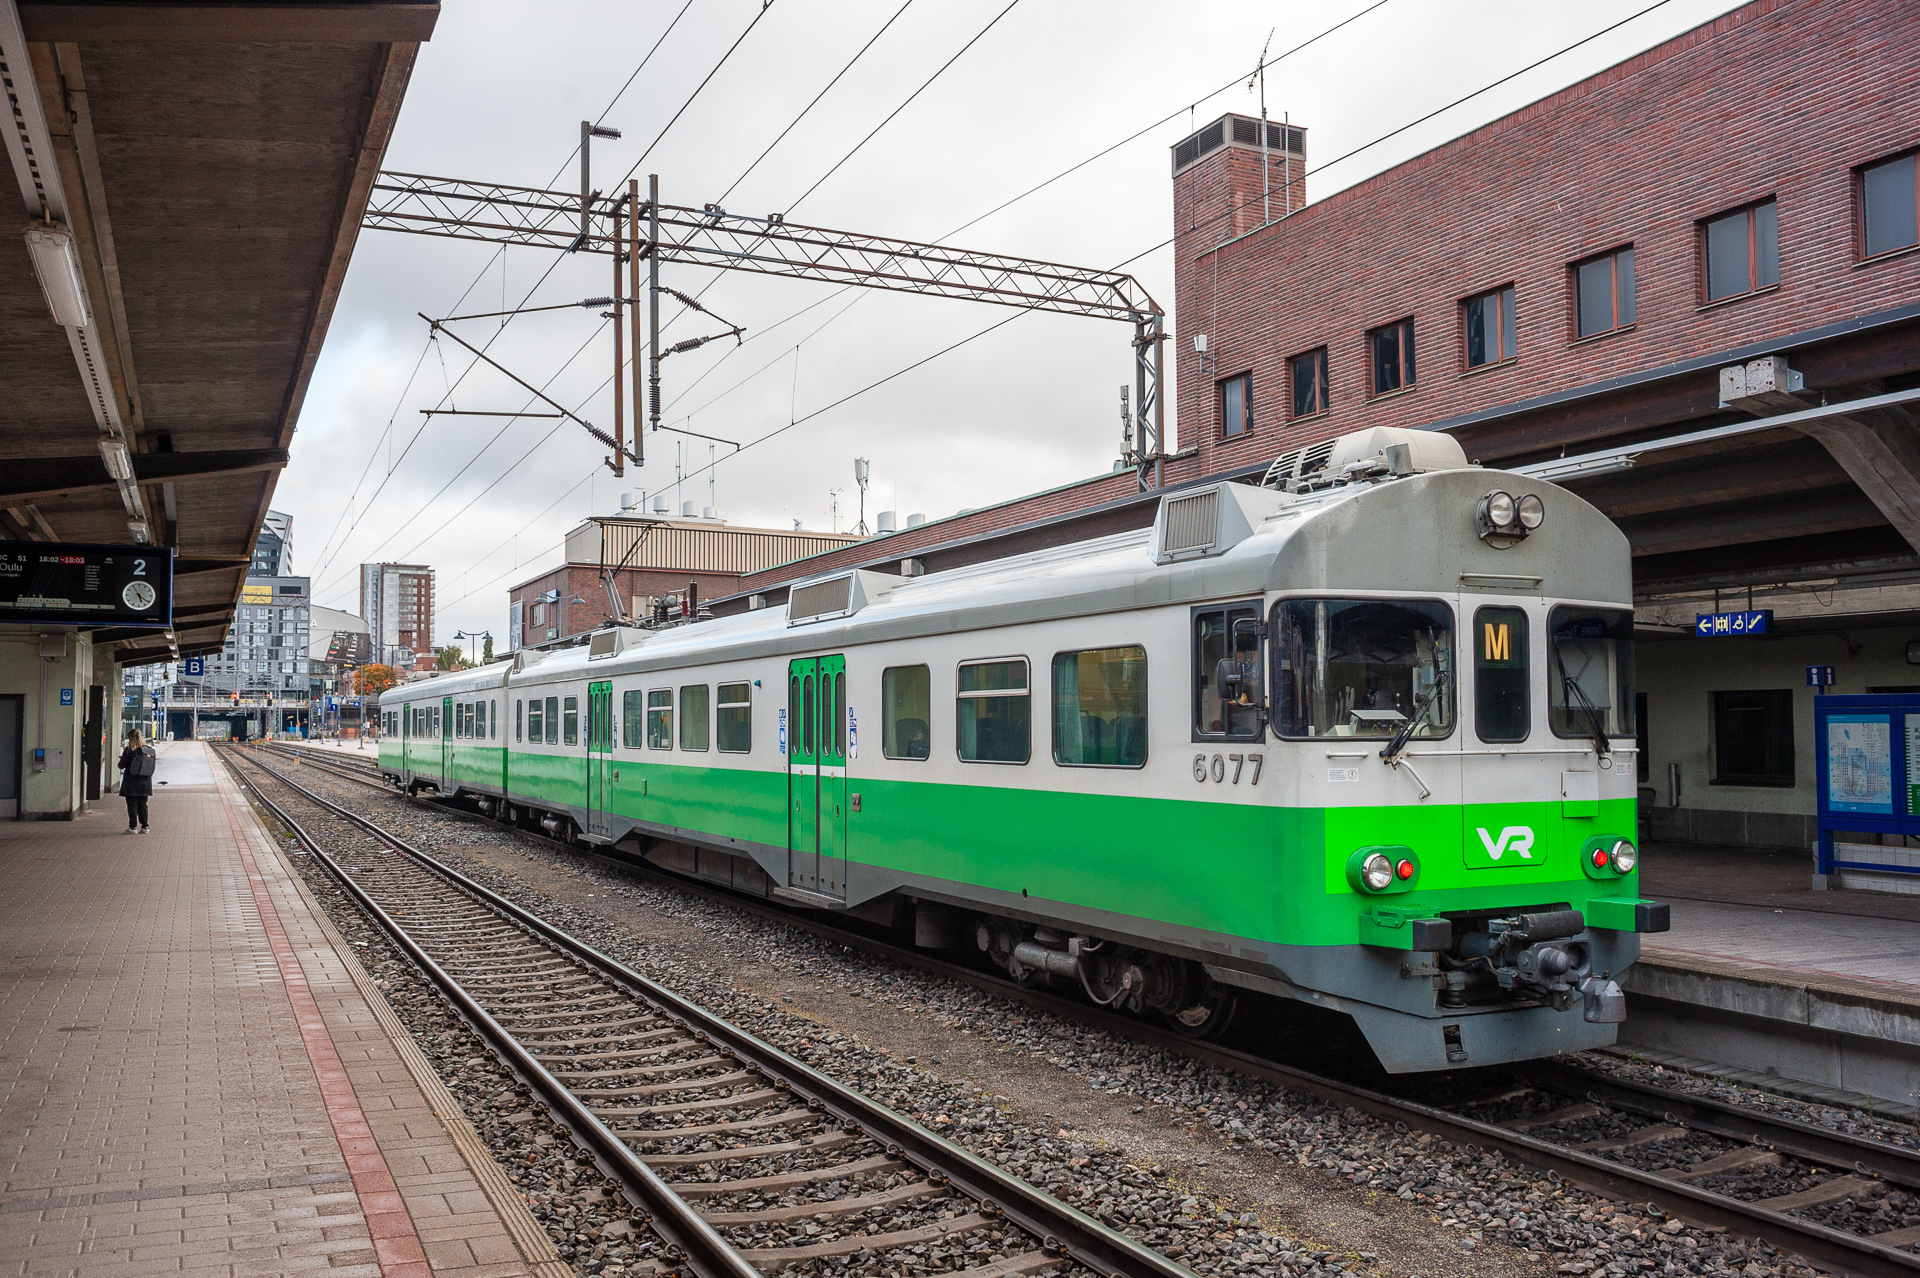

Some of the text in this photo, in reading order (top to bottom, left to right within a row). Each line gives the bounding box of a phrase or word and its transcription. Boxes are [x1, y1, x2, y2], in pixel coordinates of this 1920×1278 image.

[0, 563, 23, 572] Oulu
[133, 559, 146, 576] 2
[1484, 623, 1509, 660] M
[190, 661, 200, 673] B
[1192, 753, 1263, 786] 6077
[1476, 826, 1535, 860] VR
